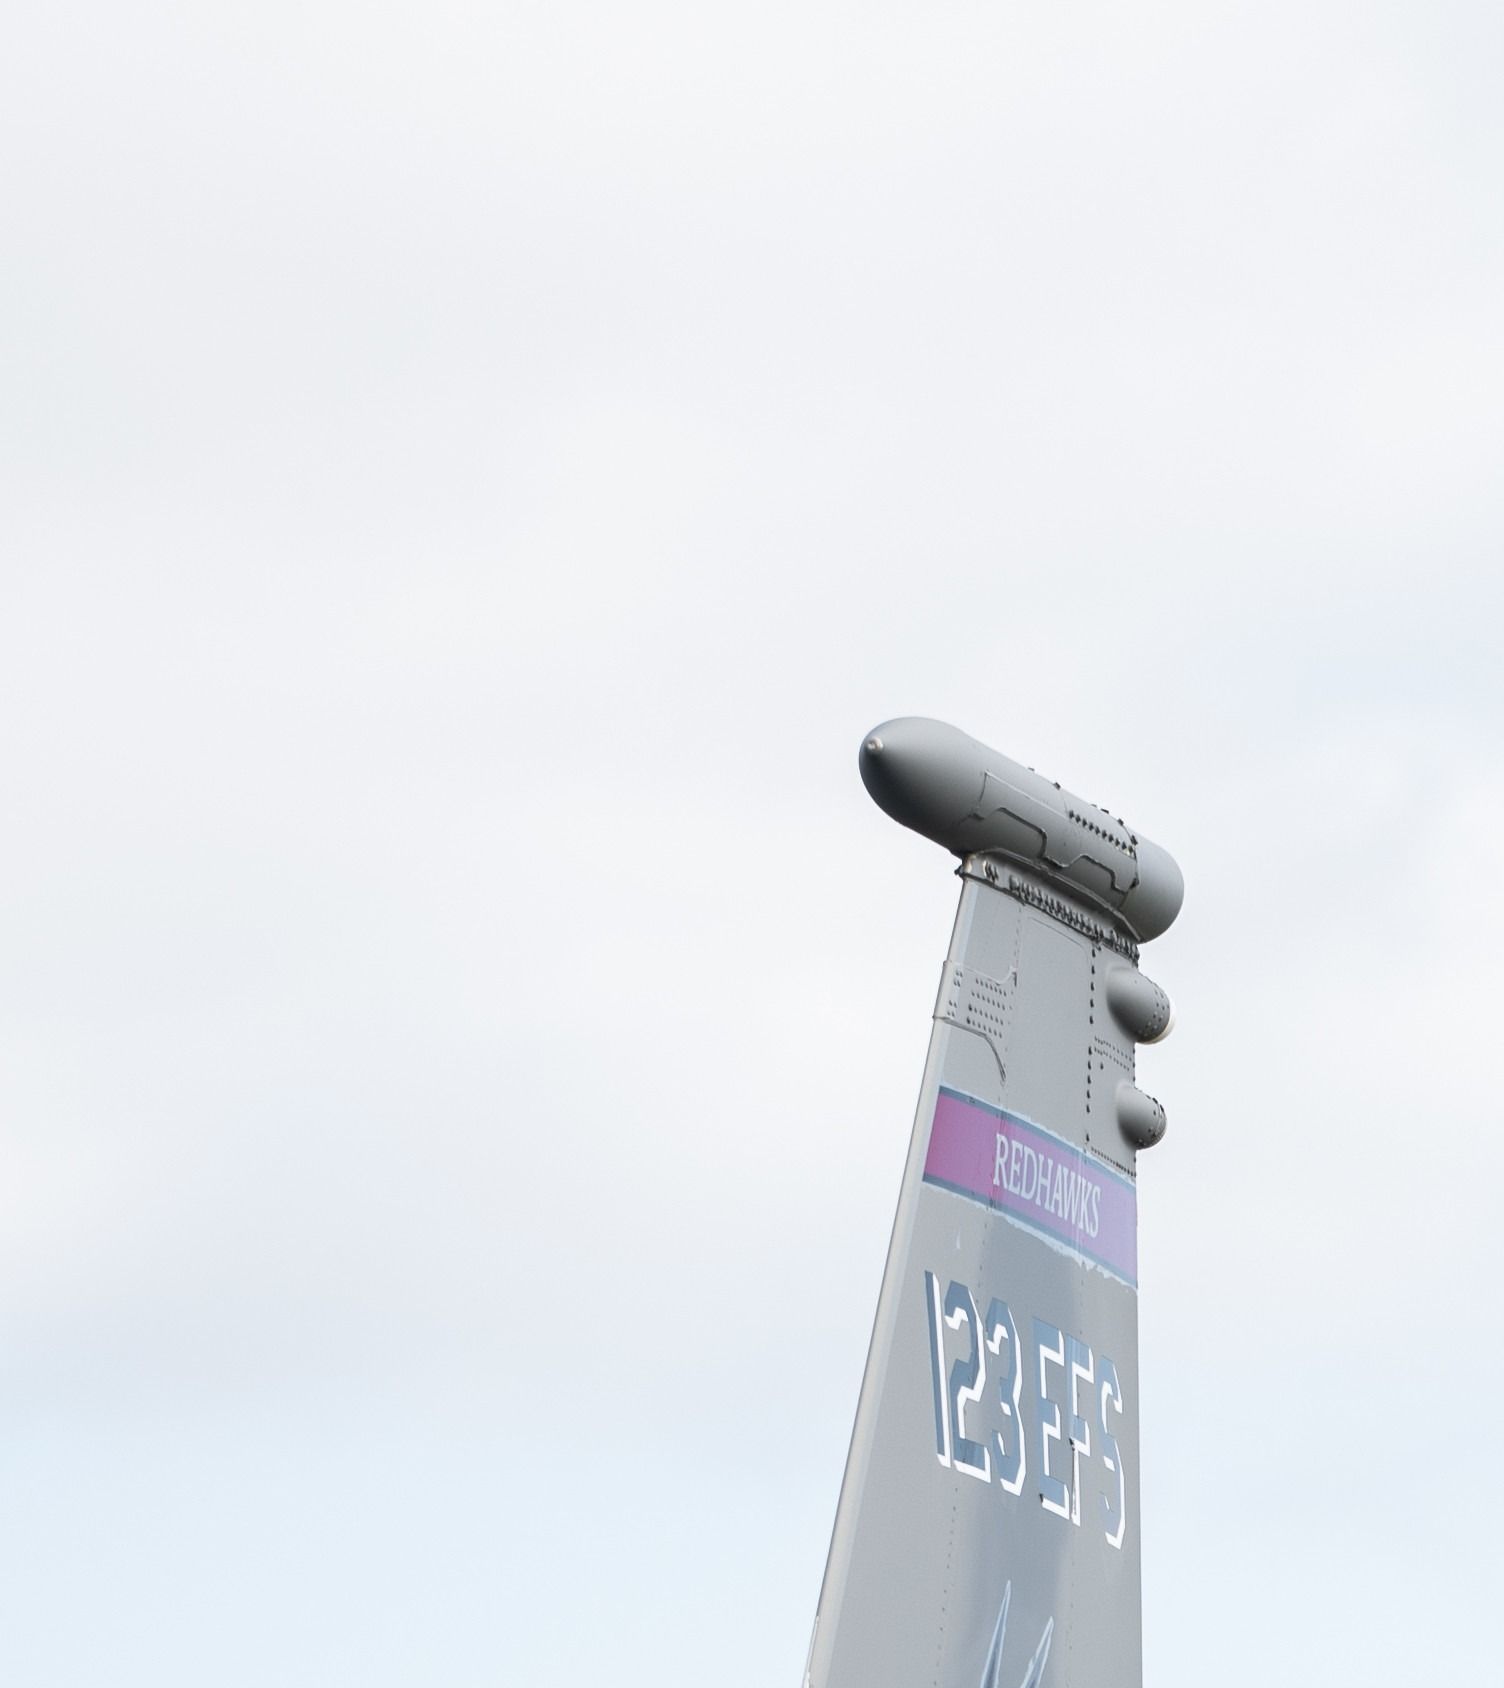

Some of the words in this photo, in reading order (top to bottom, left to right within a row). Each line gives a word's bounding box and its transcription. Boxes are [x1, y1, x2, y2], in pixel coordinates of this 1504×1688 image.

[993, 1132, 1102, 1239] REDHAWKS
[924, 1270, 1027, 1497] 123
[1032, 1315, 1127, 1551] EFS
